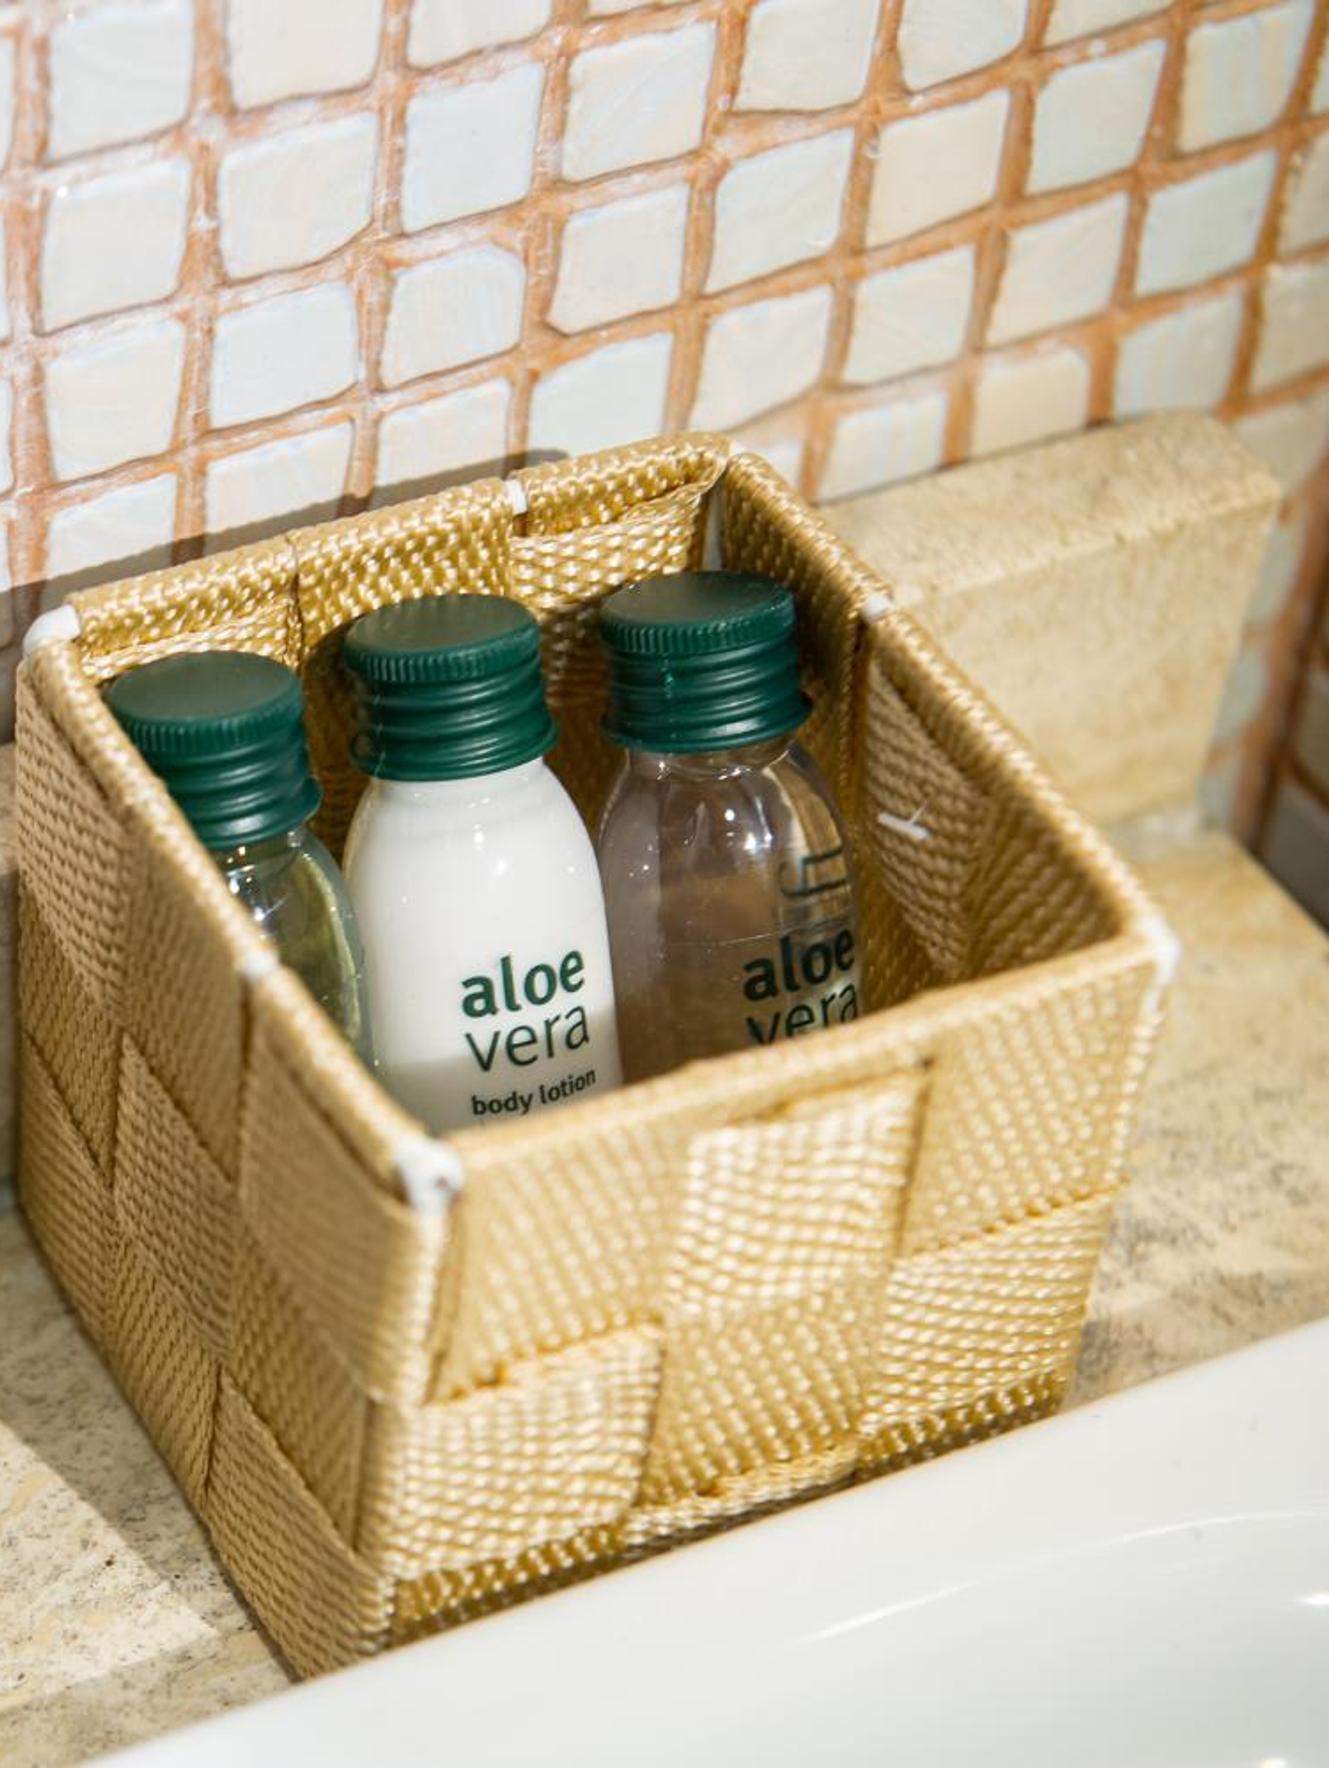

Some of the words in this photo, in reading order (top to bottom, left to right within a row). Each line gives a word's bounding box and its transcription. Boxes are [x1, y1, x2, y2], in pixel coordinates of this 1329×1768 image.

[461, 950, 584, 1018] aloe
[743, 928, 855, 1001] aloe
[464, 1005, 590, 1072] vera
[745, 983, 858, 1045] vera
[471, 1091, 532, 1115] body
[539, 1069, 597, 1104] lotion
